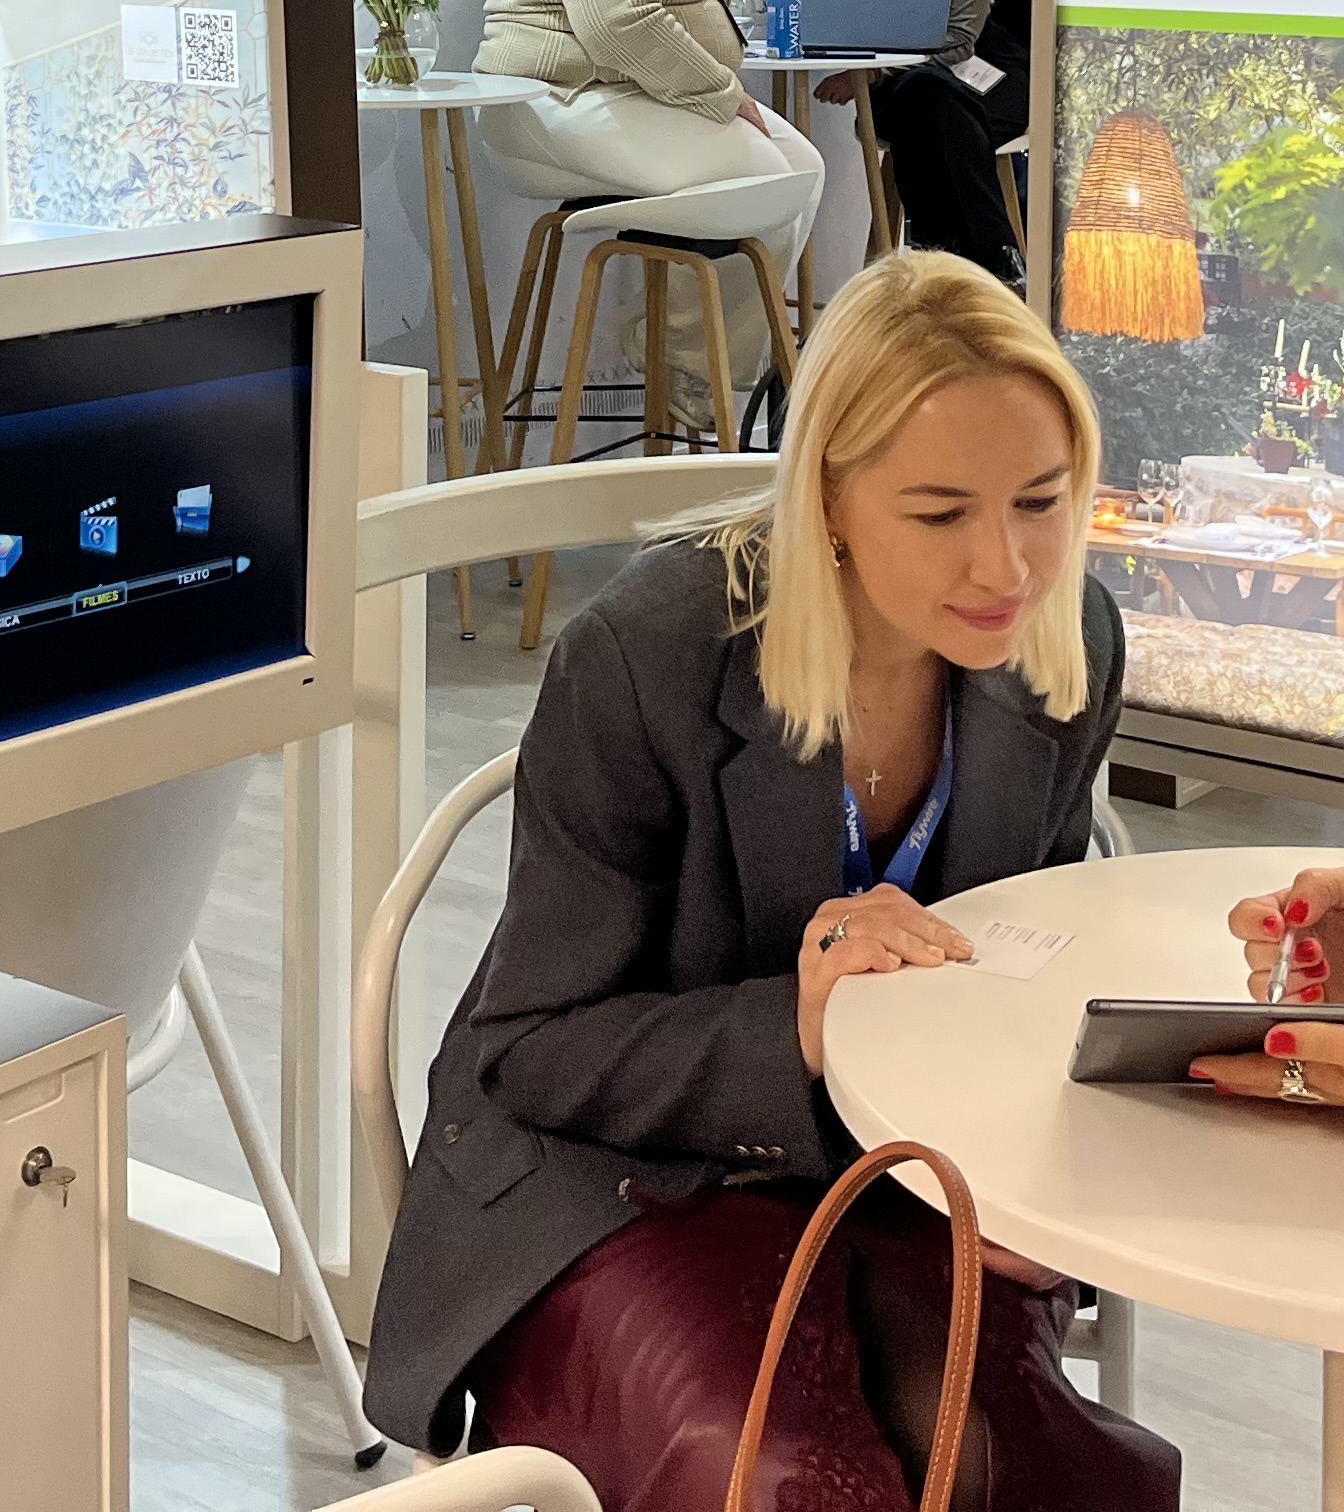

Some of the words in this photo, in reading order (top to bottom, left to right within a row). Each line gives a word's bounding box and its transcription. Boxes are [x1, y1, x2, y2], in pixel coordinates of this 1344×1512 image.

[788, 3, 800, 50] WATER
[82, 589, 120, 609] FILMES
[177, 568, 210, 585] TEXTO
